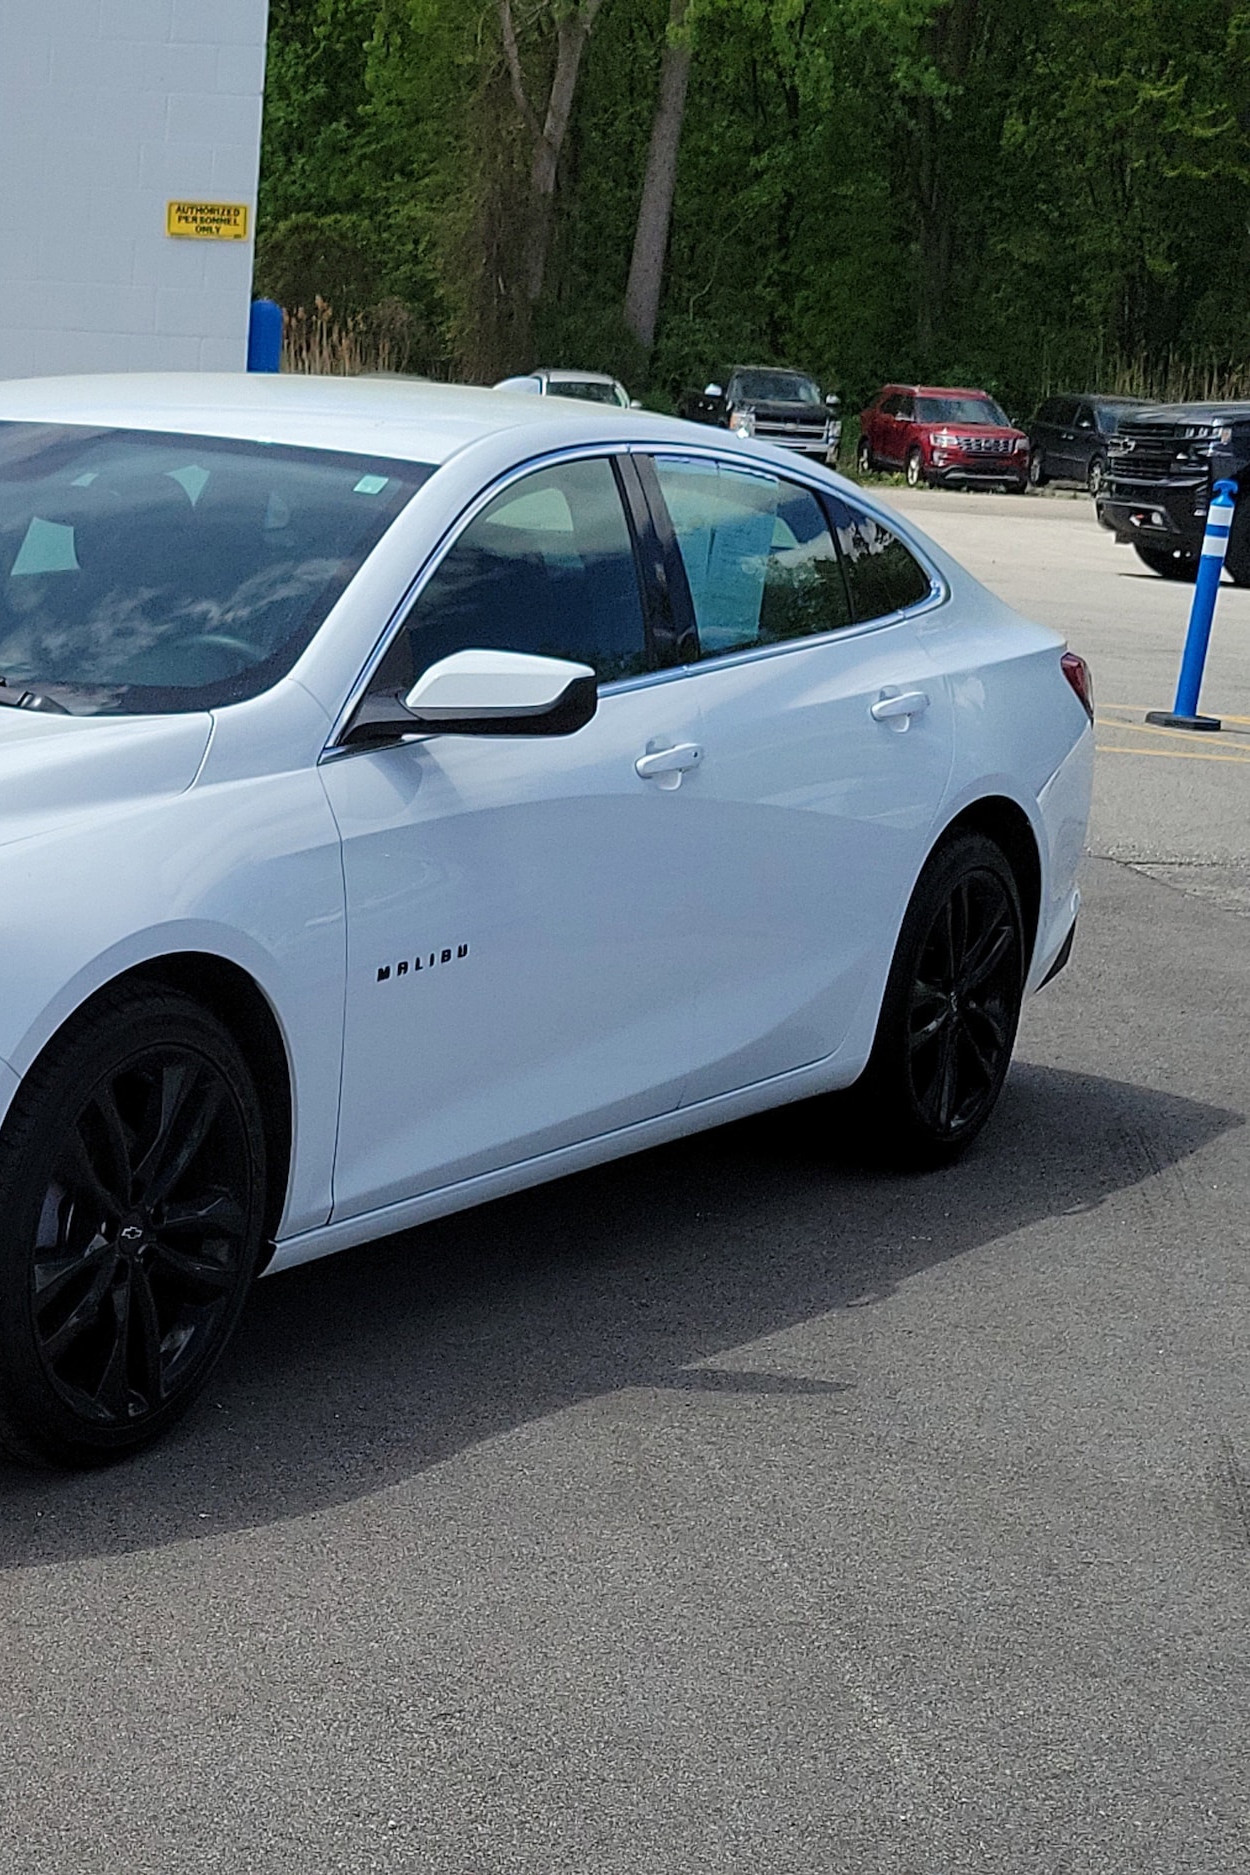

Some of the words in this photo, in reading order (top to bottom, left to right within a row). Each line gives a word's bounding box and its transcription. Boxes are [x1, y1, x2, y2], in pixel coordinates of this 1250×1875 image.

[175, 205, 240, 217] AUTHORIZED
[178, 215, 239, 226] PERSONNEL
[195, 225, 221, 234] ONLY
[376, 943, 468, 982] MALIBU
